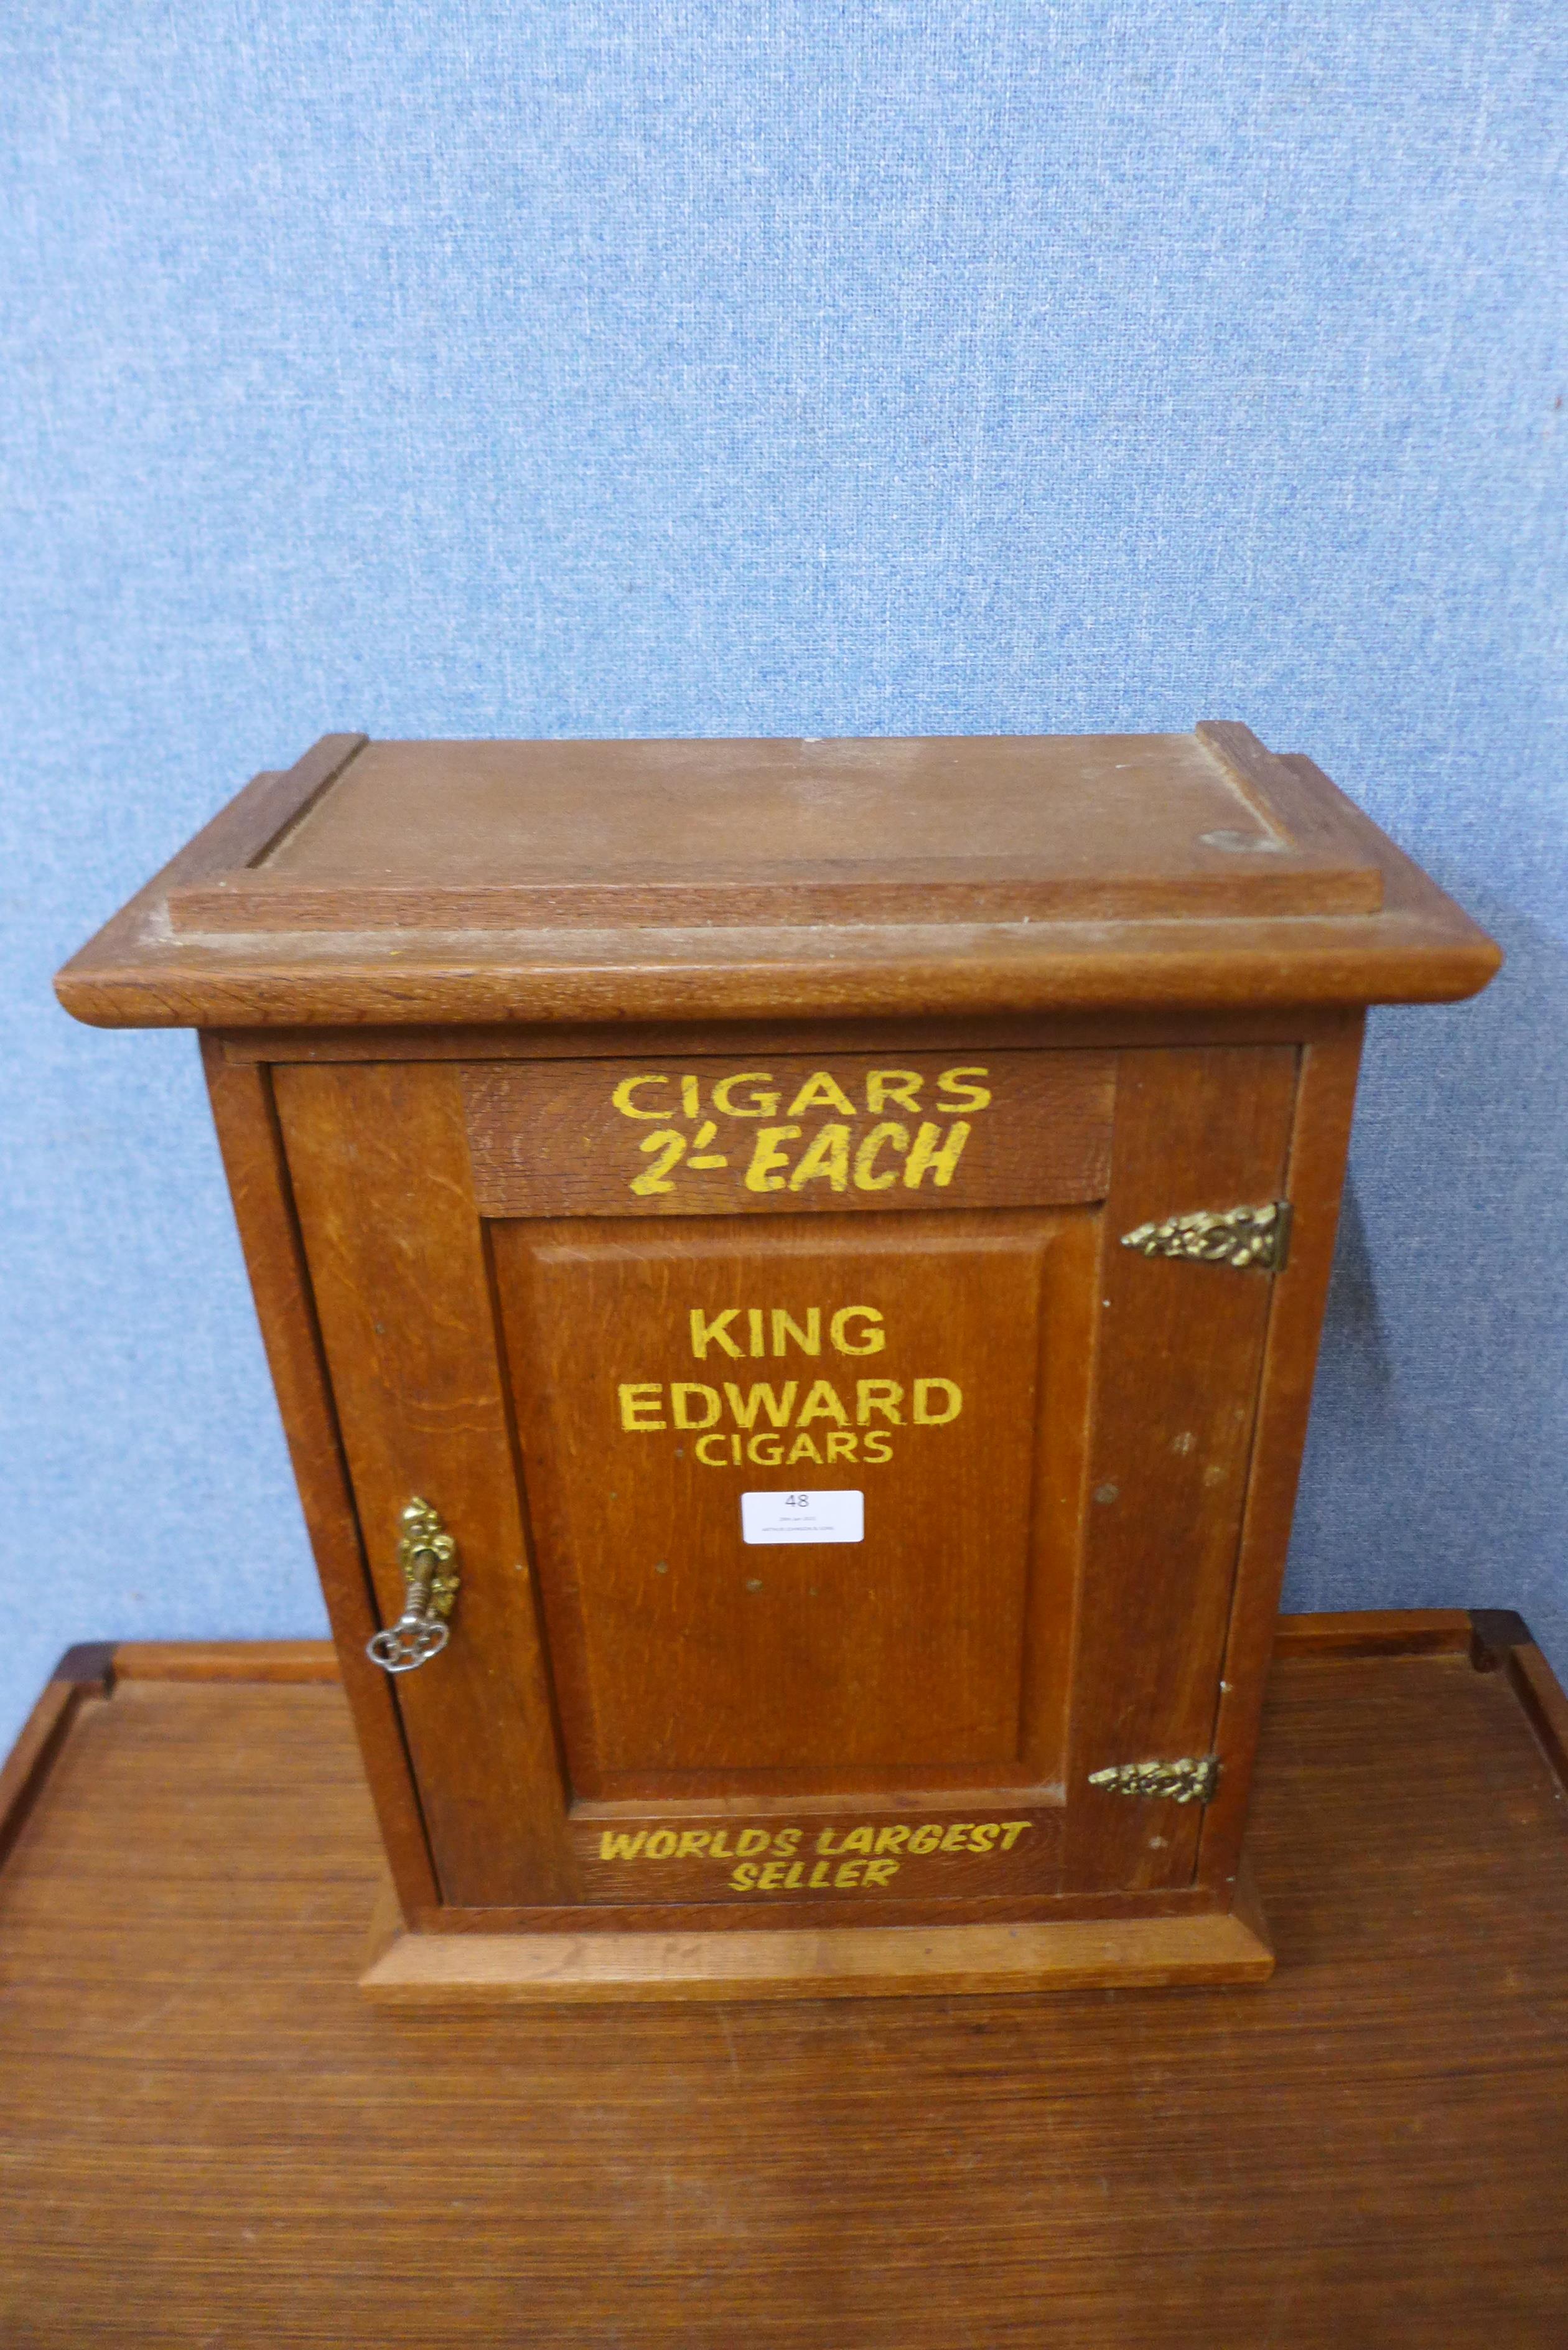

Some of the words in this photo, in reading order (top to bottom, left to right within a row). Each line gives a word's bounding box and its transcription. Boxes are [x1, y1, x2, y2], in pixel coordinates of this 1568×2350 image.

[612, 1067, 992, 1120] CIGARS
[744, 1121, 971, 1192] EACH
[689, 1305, 886, 1360] KING
[618, 1377, 964, 1432] EDWARD
[694, 1430, 894, 1468] CIGARS
[785, 1494, 809, 1508] 48
[599, 1827, 803, 1860] WORLDS
[815, 1821, 1033, 1856] LARGEST
[728, 1858, 900, 1892] SELLER
